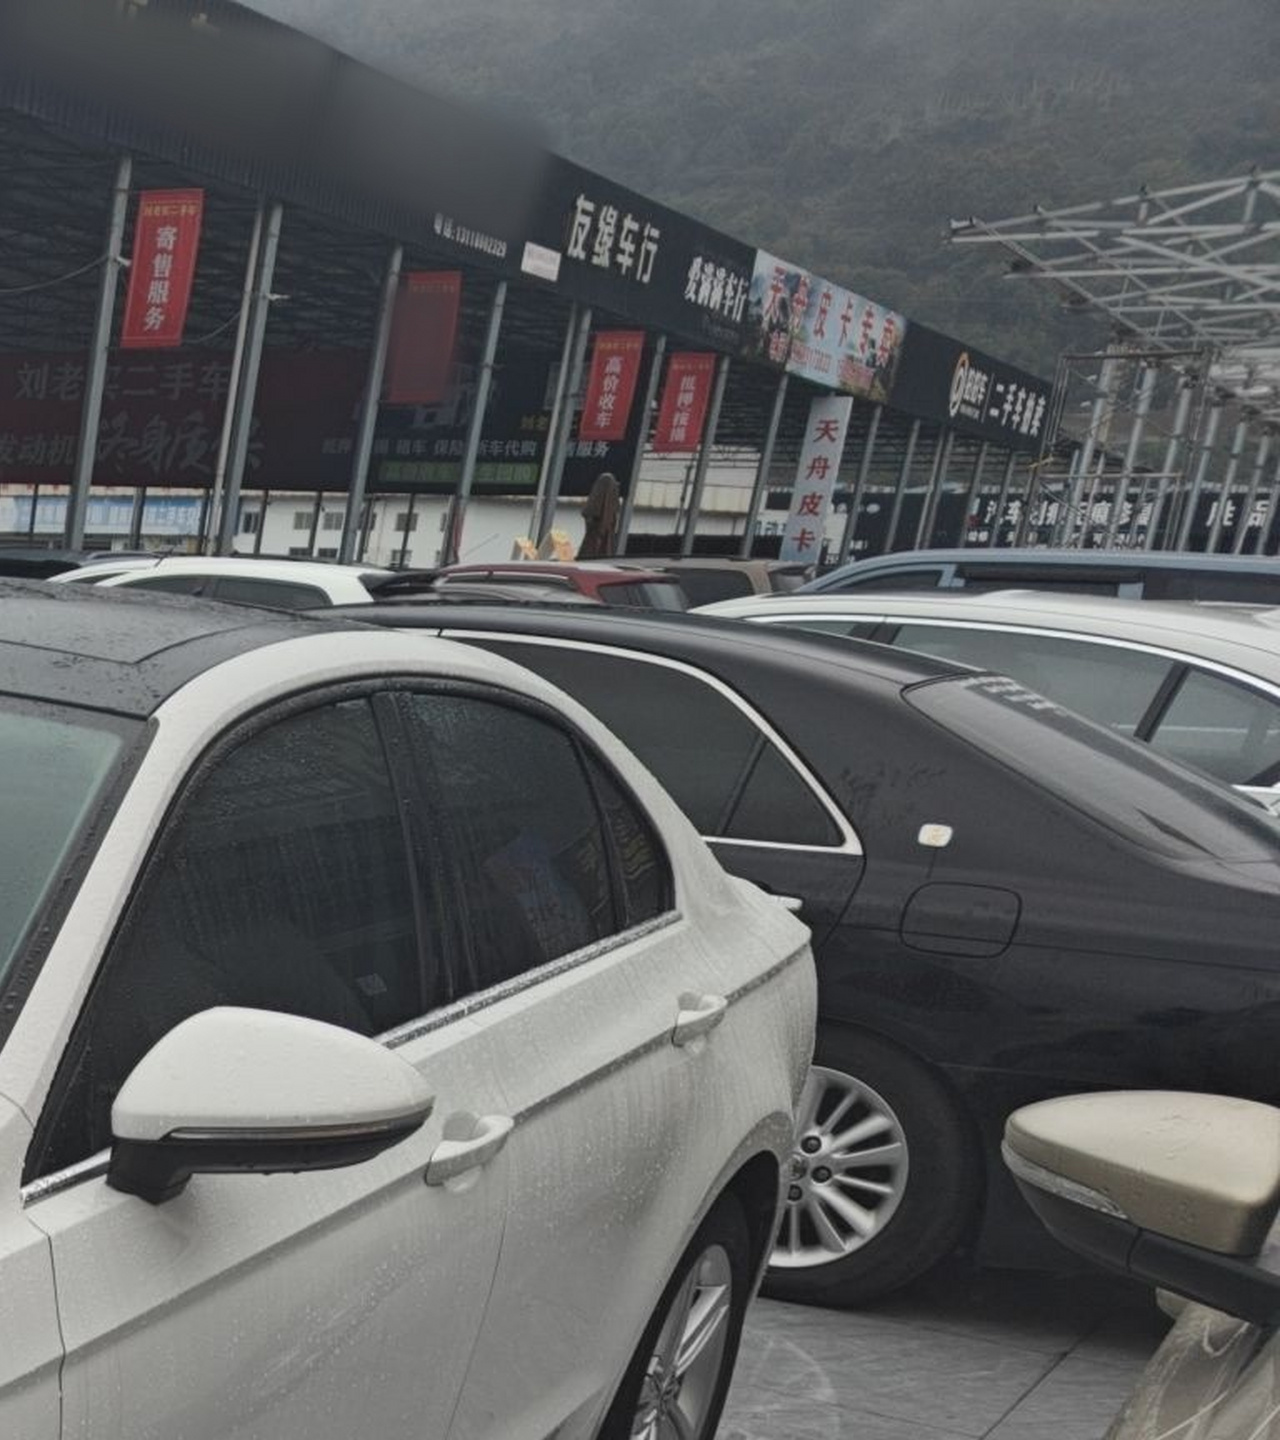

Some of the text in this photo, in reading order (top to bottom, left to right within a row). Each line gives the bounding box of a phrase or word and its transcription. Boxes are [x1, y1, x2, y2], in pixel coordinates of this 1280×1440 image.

[143, 225, 178, 333] 寄售服务
[566, 192, 661, 285] 友缘车行
[594, 355, 625, 429] 高价收车
[790, 418, 839, 553] 天舟皮卡
